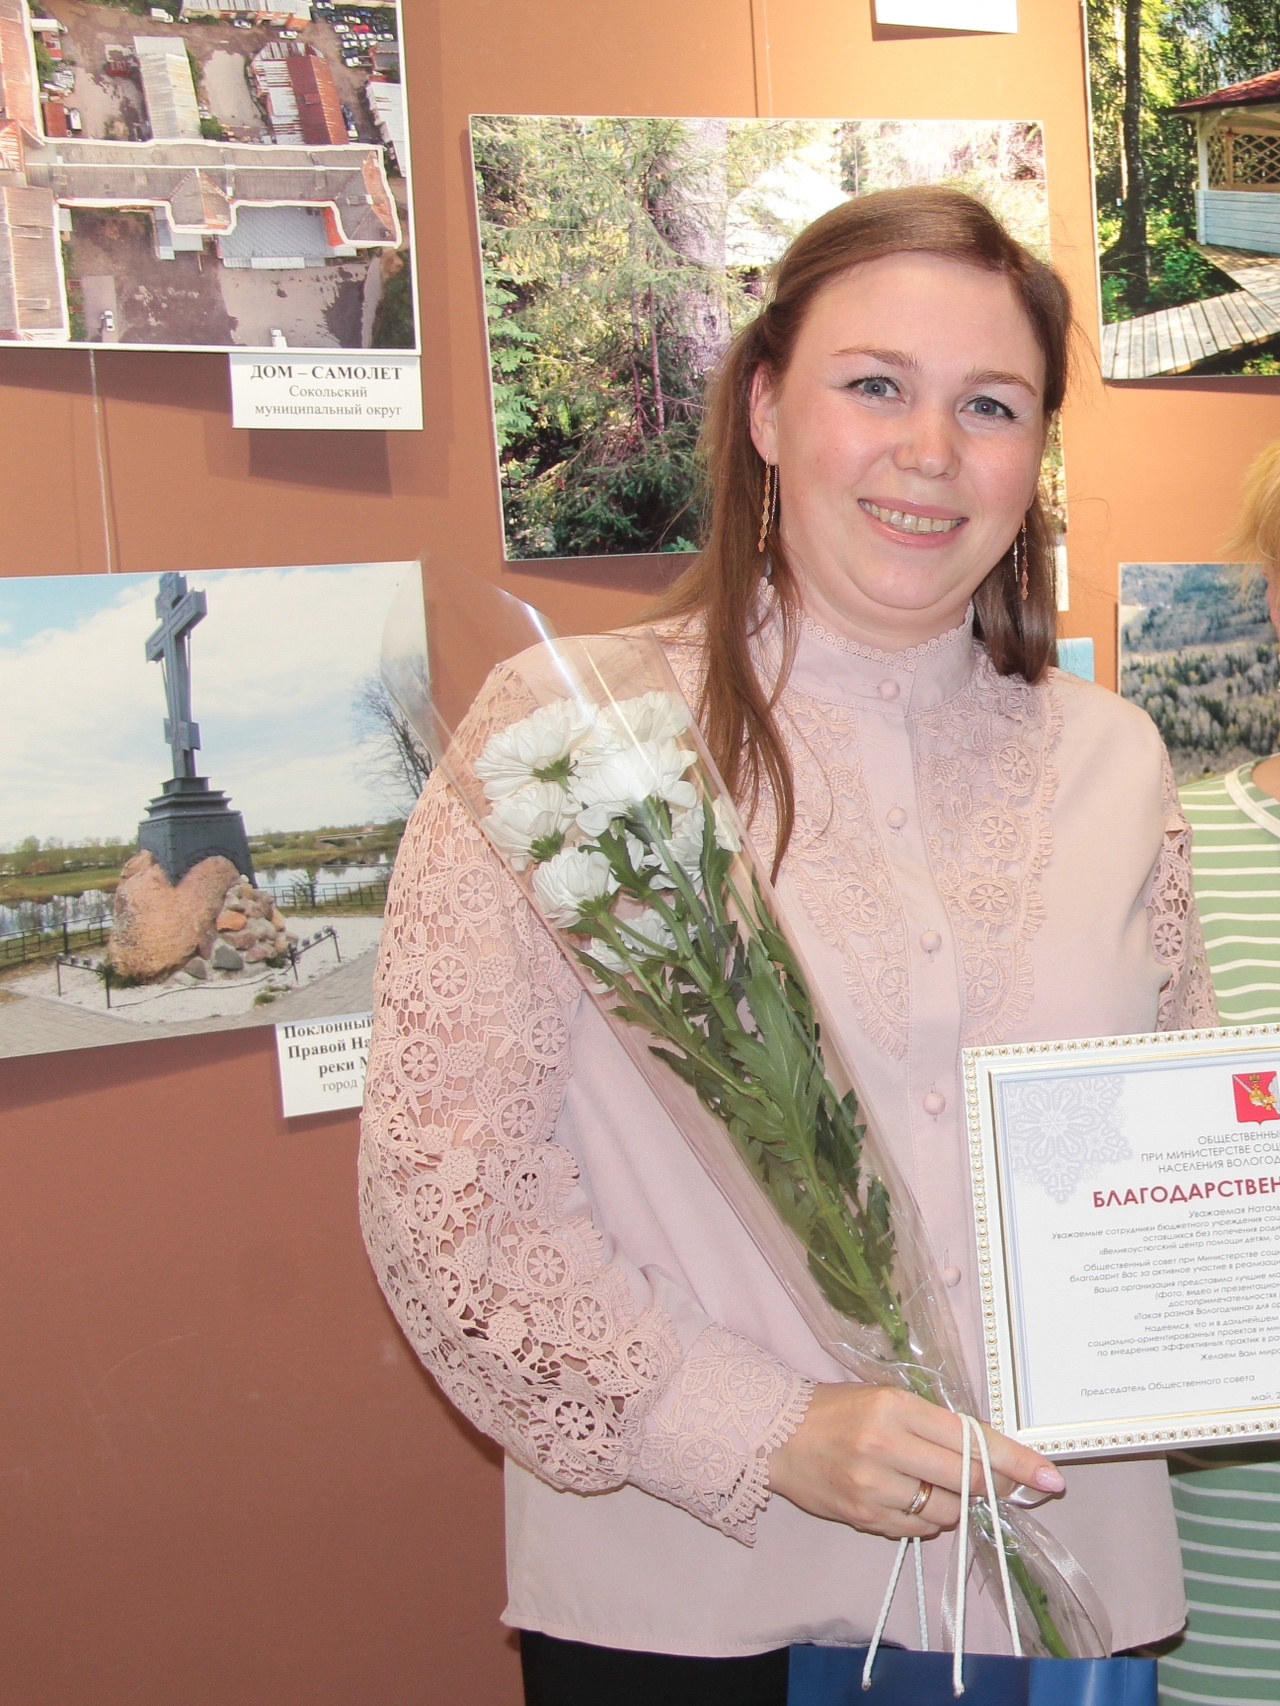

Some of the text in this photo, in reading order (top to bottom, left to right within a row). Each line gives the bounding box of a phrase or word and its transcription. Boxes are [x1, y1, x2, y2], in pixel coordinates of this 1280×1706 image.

[251, 365, 293, 380] ДОМ
[312, 366, 402, 380] САМОЛЕТ
[289, 385, 368, 398] Сокольский
[255, 404, 402, 418] муниципальный округ
[284, 1014, 374, 1039] Поклонный
[288, 1039, 346, 1060] Правой
[319, 1061, 355, 1078] реки
[322, 1078, 358, 1092] город
[1140, 1152, 1163, 1162] ПРИ
[1166, 1144, 1251, 1160] МИНИСТЕРСТВЕ
[1158, 1159, 1224, 1173] НАСЕЛЕНИЯ
[1188, 1207, 1245, 1218] Уважаемая
[1051, 1229, 1103, 1239] Уважаемые
[1105, 1225, 1155, 1235] сотрудники
[1156, 1220, 1209, 1231] бюджетного
[1211, 1216, 1262, 1227] учреждения
[1142, 1232, 1194, 1242] оставшихся
[1195, 1229, 1211, 1237] без
[1212, 1226, 1257, 1236] попечения
[1178, 1241, 1204, 1249] центр
[1205, 1238, 1243, 1246] помощи
[1083, 1258, 1151, 1272] Общественный
[1152, 1258, 1176, 1266] совет
[1196, 1251, 1258, 1262] Министерстве
[1069, 1272, 1119, 1283] благодарит
[1121, 1270, 1138, 1278] Вас
[1151, 1267, 1191, 1276] активное
[1192, 1263, 1227, 1273] участие
[1093, 1285, 1119, 1294] Ваша
[1120, 1281, 1175, 1292] организация
[1177, 1276, 1233, 1287] представила
[1234, 1273, 1266, 1282] лучшие
[1186, 1287, 1212, 1296] видео
[1167, 1292, 1277, 1308] достопримечательностях
[1163, 1309, 1194, 1319] разная
[1255, 1302, 1269, 1310] для
[1222, 1315, 1279, 1326] дальнейшем
[1087, 1330, 1215, 1348] социально-ориентированных
[1217, 1327, 1257, 1337] проектов
[1109, 1345, 1159, 1356] внедрению
[1161, 1340, 1223, 1351] эффективных
[1224, 1337, 1259, 1346] практик
[1199, 1352, 1237, 1361] Желаем
[1238, 1349, 1257, 1358] Вам
[1080, 1374, 1255, 1397] Председатель Общественного совета
